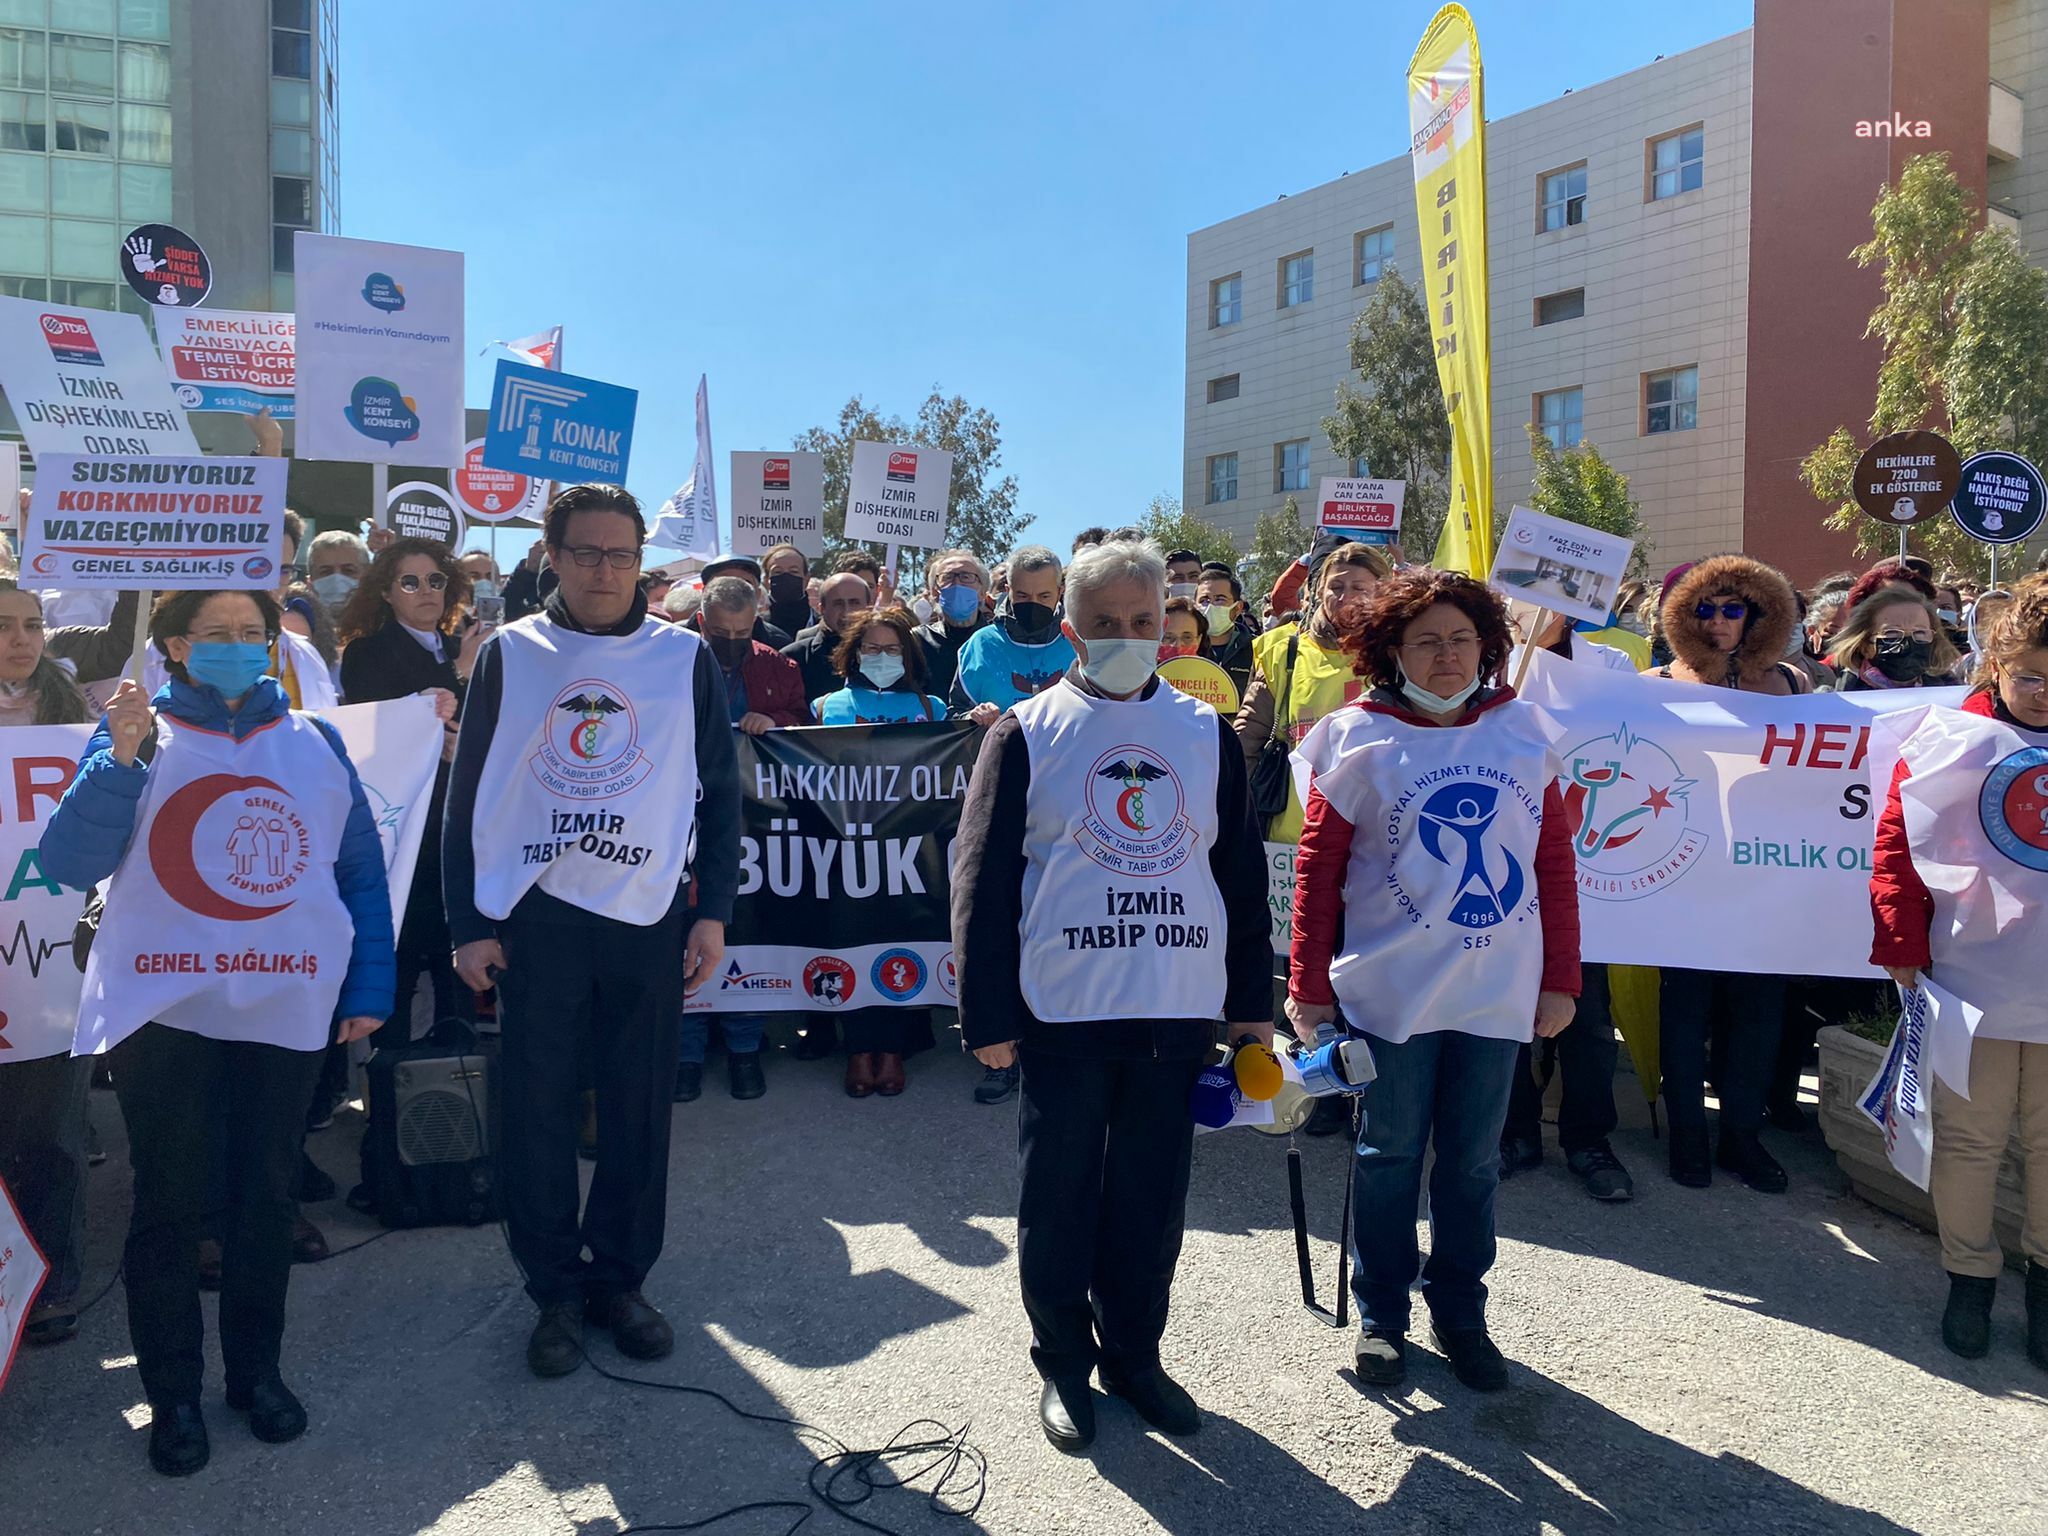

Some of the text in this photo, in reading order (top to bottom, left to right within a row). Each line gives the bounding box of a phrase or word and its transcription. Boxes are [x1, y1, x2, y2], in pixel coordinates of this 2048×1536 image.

[168, 258, 200, 275] VARSA
[184, 275, 205, 289] YOK
[62, 322, 88, 334] TDB
[314, 321, 450, 343] #HekimlerinYanındayım
[180, 350, 247, 366] TEMEL
[200, 364, 296, 385] İSTİYORUZ
[58, 373, 124, 400] İZMİR
[214, 397, 235, 406] SES
[363, 395, 391, 406] İZMİR
[25, 401, 179, 432] DİŞHEKİMLERİ
[363, 406, 392, 417] KENT
[363, 418, 411, 429] KONSEYİ
[83, 435, 150, 455] ODASI
[552, 418, 622, 456] KONAK
[549, 449, 619, 474] KENT KONSEYİ
[1876, 454, 1936, 469] HEKİMLERE
[72, 461, 257, 486] SUSMUYORUZ
[1891, 469, 1918, 480] 7200
[1973, 471, 2030, 490] ALKIŞ DEĞİL
[881, 485, 916, 504] İZMİR
[1334, 491, 1384, 500] CAN CANA
[1336, 482, 1384, 491] YAN YANA
[1870, 480, 1943, 494] EK GÖSTERGE
[1968, 482, 2030, 502] HAKLARIMIZI
[57, 490, 264, 515] KORKMUYORUZ
[760, 497, 793, 512] İZMİR
[1337, 502, 1377, 513] BİRLİKTE
[1974, 493, 2024, 513] İSTİYORUZ
[854, 502, 940, 524] DİŞHEKİMLERİ
[43, 519, 271, 546] VAZGEÇMİYORUZ
[737, 516, 816, 531] DİŞHEKİMLERİ
[876, 521, 914, 537] ODASI
[72, 557, 235, 576] GENEL SAĞLIK-İŞ
[1209, 677, 1219, 692] İŞ
[543, 748, 637, 780] TÜRK TABİPLERİ BİRLİĞİ
[541, 771, 636, 797] İZMİR TABİP ODASI
[755, 763, 900, 801] HAKKIMIZ
[1414, 765, 1471, 790] HİZMET
[244, 797, 285, 815] GENEL
[552, 809, 625, 835] İZMİR
[1388, 789, 1416, 845] SOSYAL
[1090, 819, 1184, 854] TÜRK TABİPLERİ BİRLİĞİ
[580, 834, 652, 867] ODASI
[737, 818, 926, 899] BÜYÜK
[1093, 844, 1187, 872] İZMİR TABİP ODASI
[1733, 836, 1827, 869] BİRLİK
[1632, 838, 1697, 889] SENDİKASI
[1106, 885, 1186, 916] İZMİR
[1387, 873, 1422, 924] SAĞLIK
[1461, 912, 1495, 925] 1996
[1062, 918, 1209, 950] TABİP ODASI
[1463, 934, 1492, 950] SES
[134, 947, 318, 980] GENEL SAĞLIK-İŞ
[1904, 993, 1927, 1066] SAĞLIKTA
